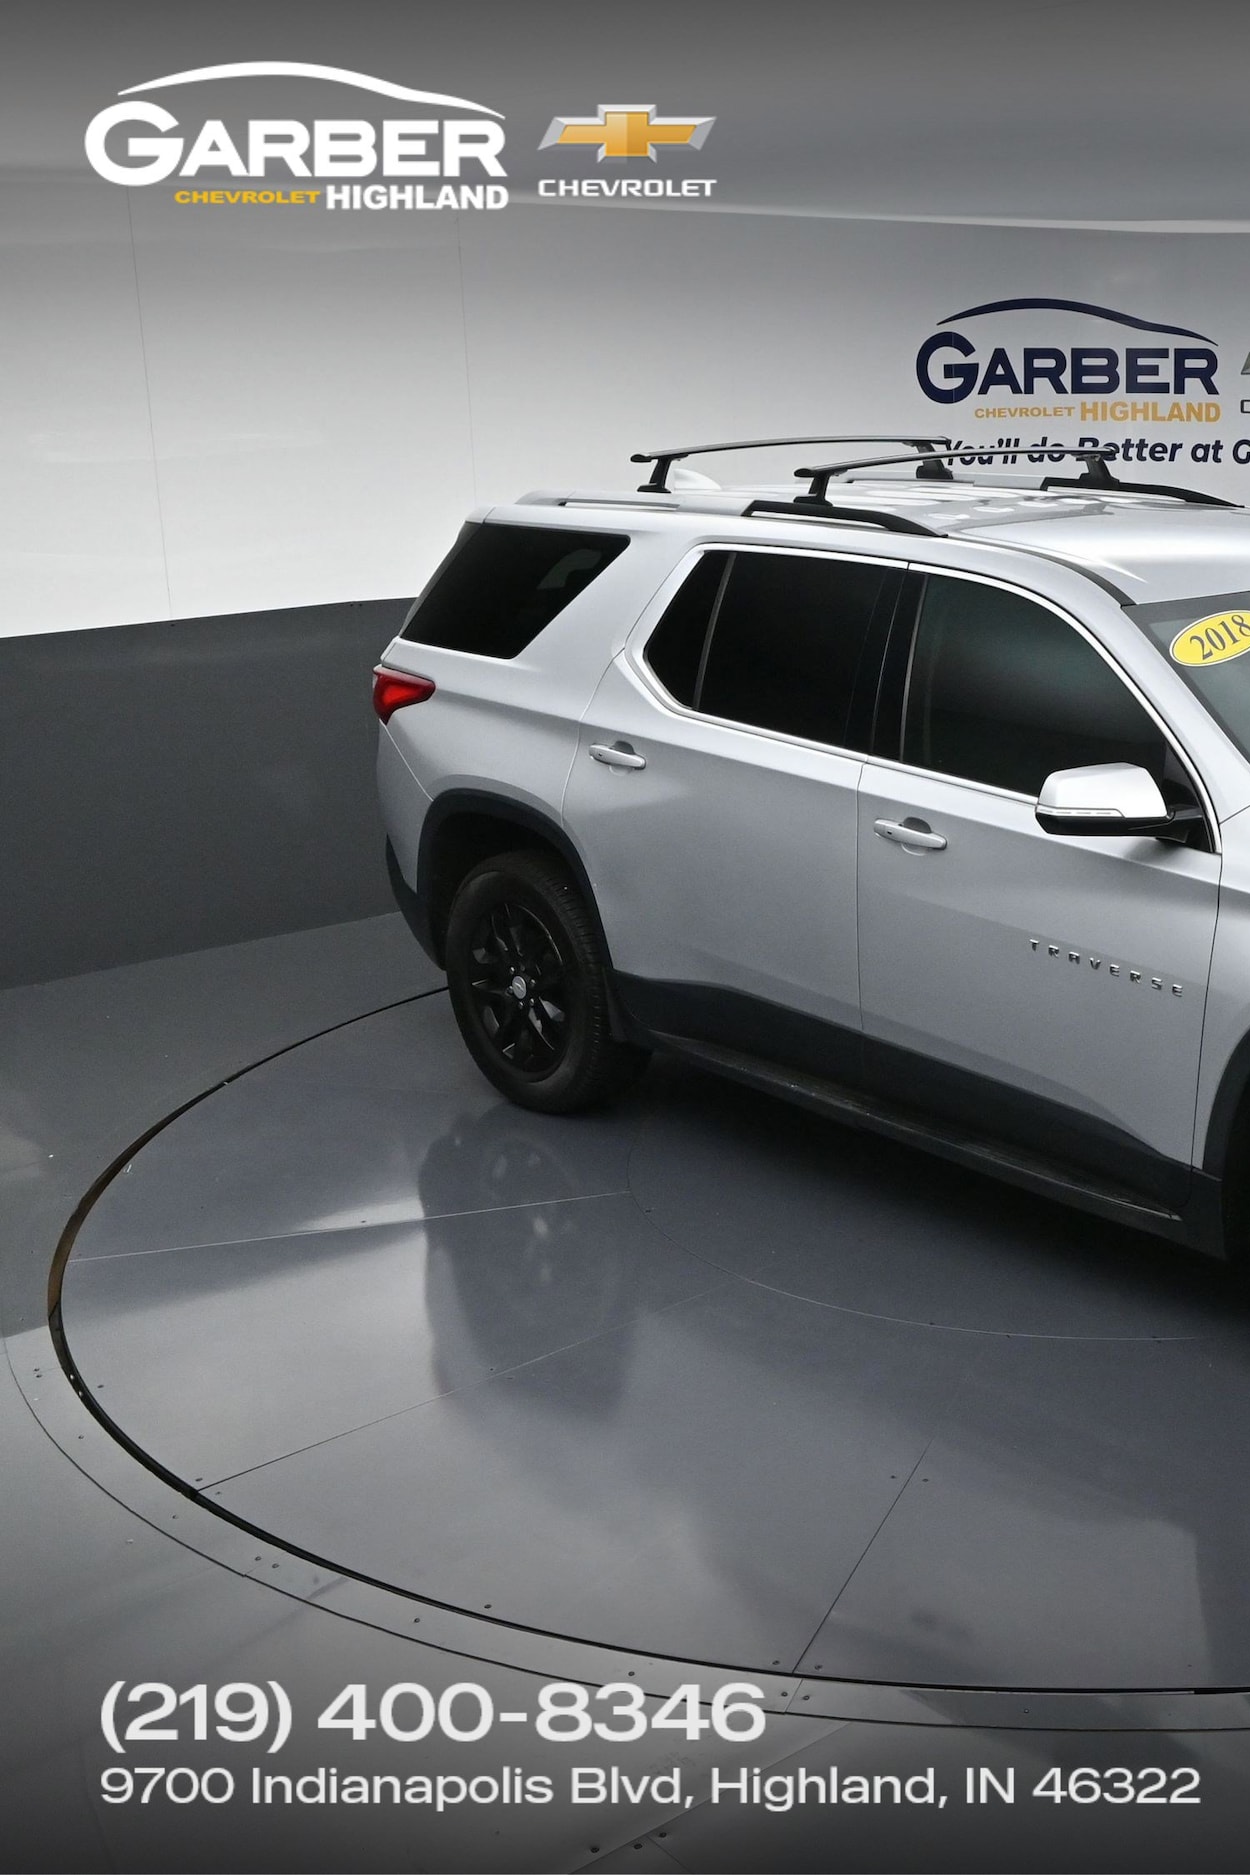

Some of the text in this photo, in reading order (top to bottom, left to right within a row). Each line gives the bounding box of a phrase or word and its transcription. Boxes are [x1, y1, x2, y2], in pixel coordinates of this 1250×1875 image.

[916, 331, 1220, 405] GARBER
[974, 401, 1222, 423] CHEVROLET HIGHLAND
[1028, 436, 1066, 463] do
[1190, 438, 1224, 464] at
[1029, 938, 1184, 998] TRAVERSE
